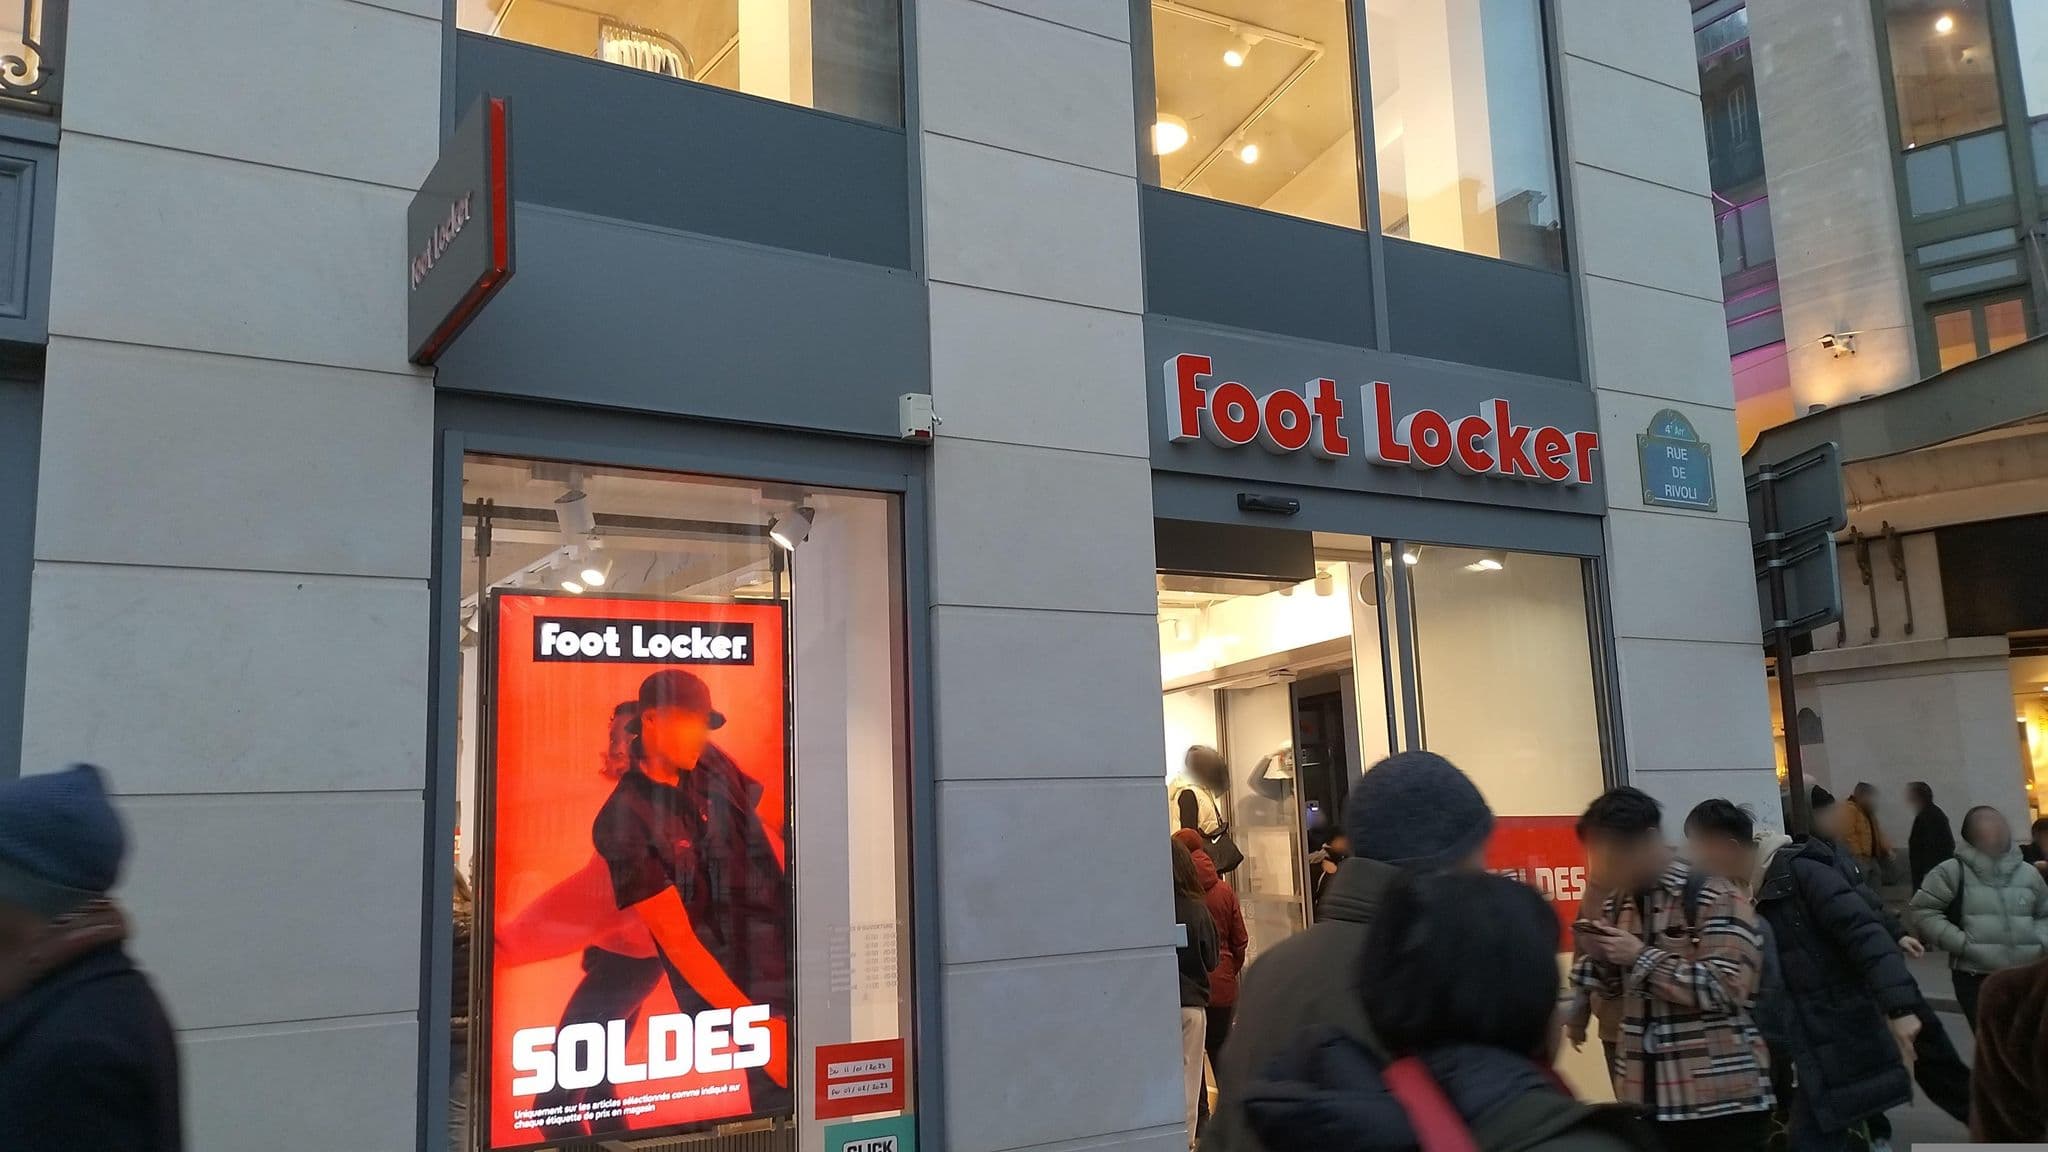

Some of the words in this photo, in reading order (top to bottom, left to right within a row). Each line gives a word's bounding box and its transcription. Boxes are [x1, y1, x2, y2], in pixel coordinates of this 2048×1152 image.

[1165, 353, 1350, 460] Foot
[1362, 381, 1599, 486] Locker
[1666, 446, 1689, 461] RUE
[1671, 466, 1687, 480] DE
[1664, 484, 1698, 500] RIVOLI
[541, 622, 621, 657] Foot
[1484, 866, 1587, 902] DES
[512, 1003, 771, 1097] SOLDES
[513, 1117, 545, 1130] chaque
[545, 1113, 582, 1126] étiquette
[583, 1110, 594, 1120] de
[595, 1108, 610, 1121] prix
[611, 1108, 622, 1116] en
[623, 1103, 656, 1115] magasin
[514, 1105, 563, 1119] Uniquement
[564, 1104, 578, 1113] sur
[578, 1102, 592, 1111] les
[592, 1098, 621, 1110] articles
[622, 1091, 671, 1106] sélectionnés
[671, 1088, 700, 1099] comme
[701, 1083, 728, 1096] indiqué
[728, 1083, 741, 1092] sur
